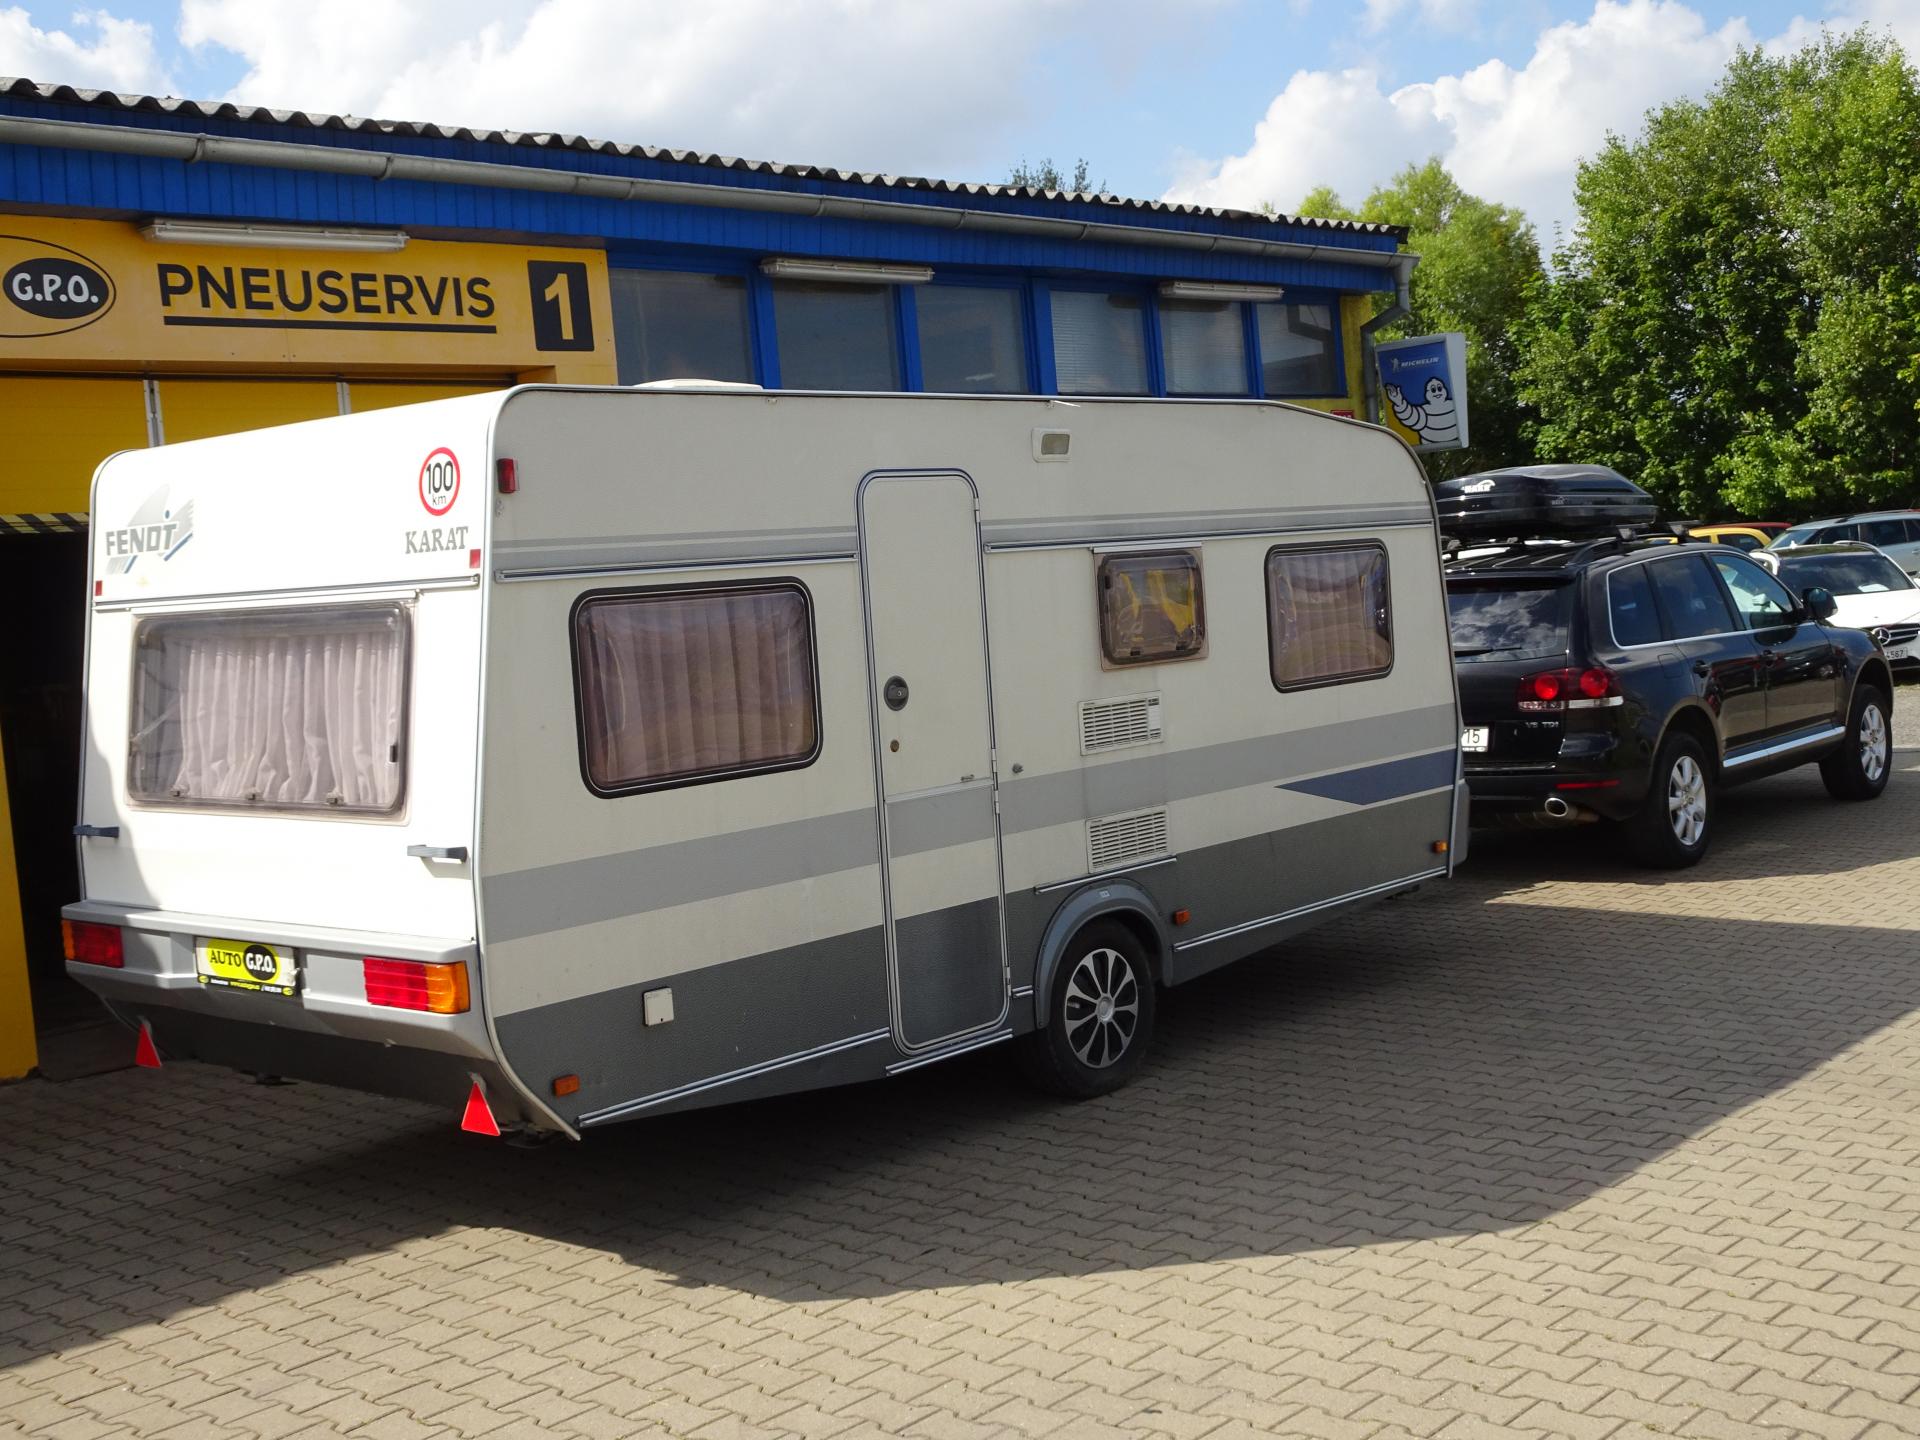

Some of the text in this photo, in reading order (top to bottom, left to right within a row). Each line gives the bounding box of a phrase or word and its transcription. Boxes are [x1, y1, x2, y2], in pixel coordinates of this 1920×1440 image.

[12, 272, 99, 304] G.P.O.
[157, 263, 496, 319] PNEUSERVIS
[544, 272, 575, 340] 1
[1400, 357, 1440, 367] MICHELIN
[425, 460, 454, 494] 100
[432, 494, 447, 506] km
[105, 523, 177, 556] FENDT
[405, 526, 469, 554] KARAT
[210, 950, 276, 973] AUTO G.P.O.
